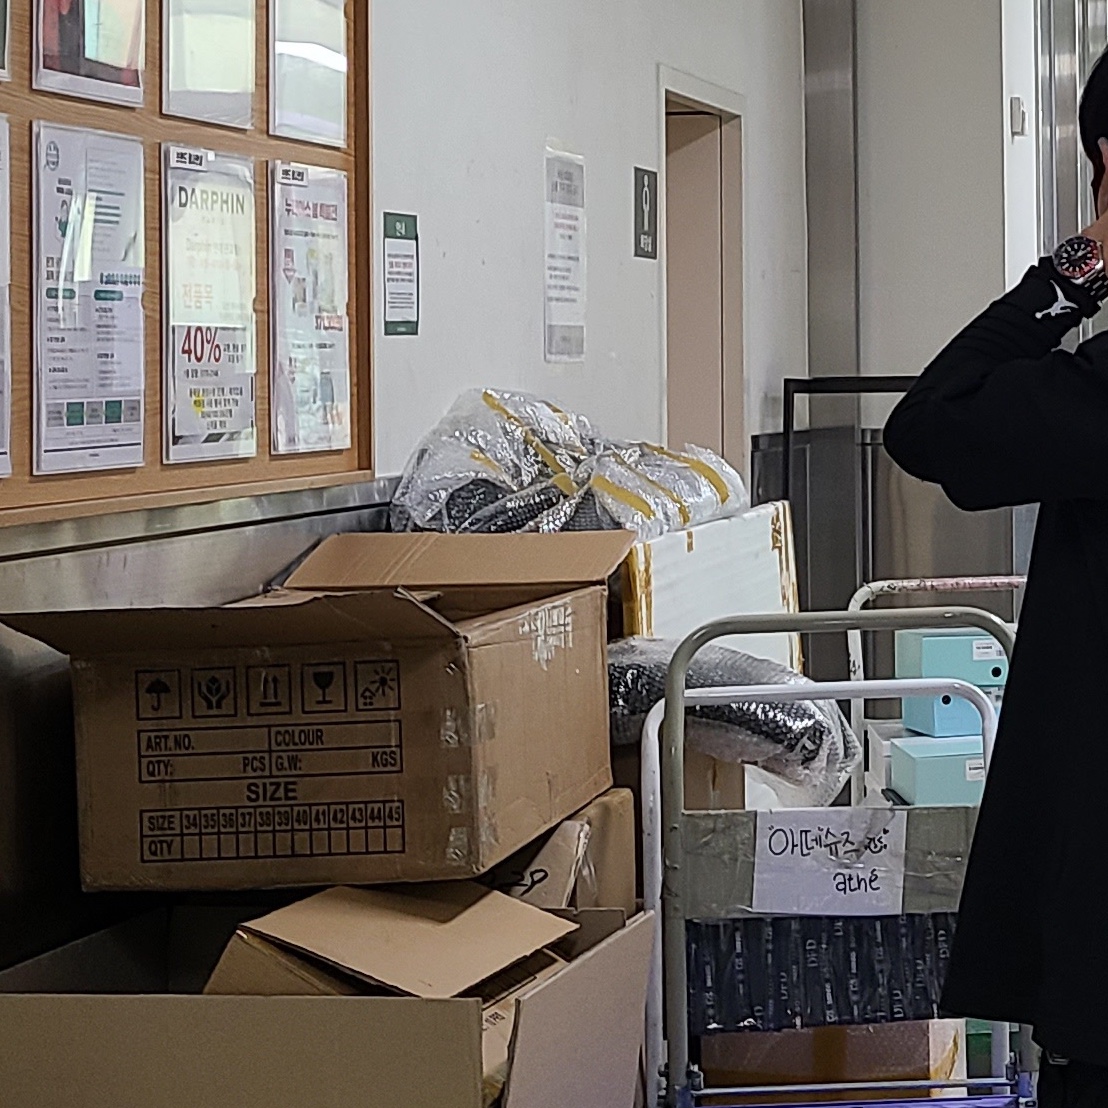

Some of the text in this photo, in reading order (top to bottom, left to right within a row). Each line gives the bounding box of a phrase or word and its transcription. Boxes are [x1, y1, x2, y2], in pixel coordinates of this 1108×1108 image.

[178, 185, 245, 214] DARPHIN
[181, 326, 222, 363] 40%
[274, 728, 324, 747] COLOUR
[242, 755, 267, 773] PCS
[371, 750, 398, 768] KGS
[246, 780, 298, 803] SIZE
[147, 805, 401, 832] SIZE 34 35 36 37 38 39 40 41 42 43 44 45
[148, 839, 174, 857] QTY
